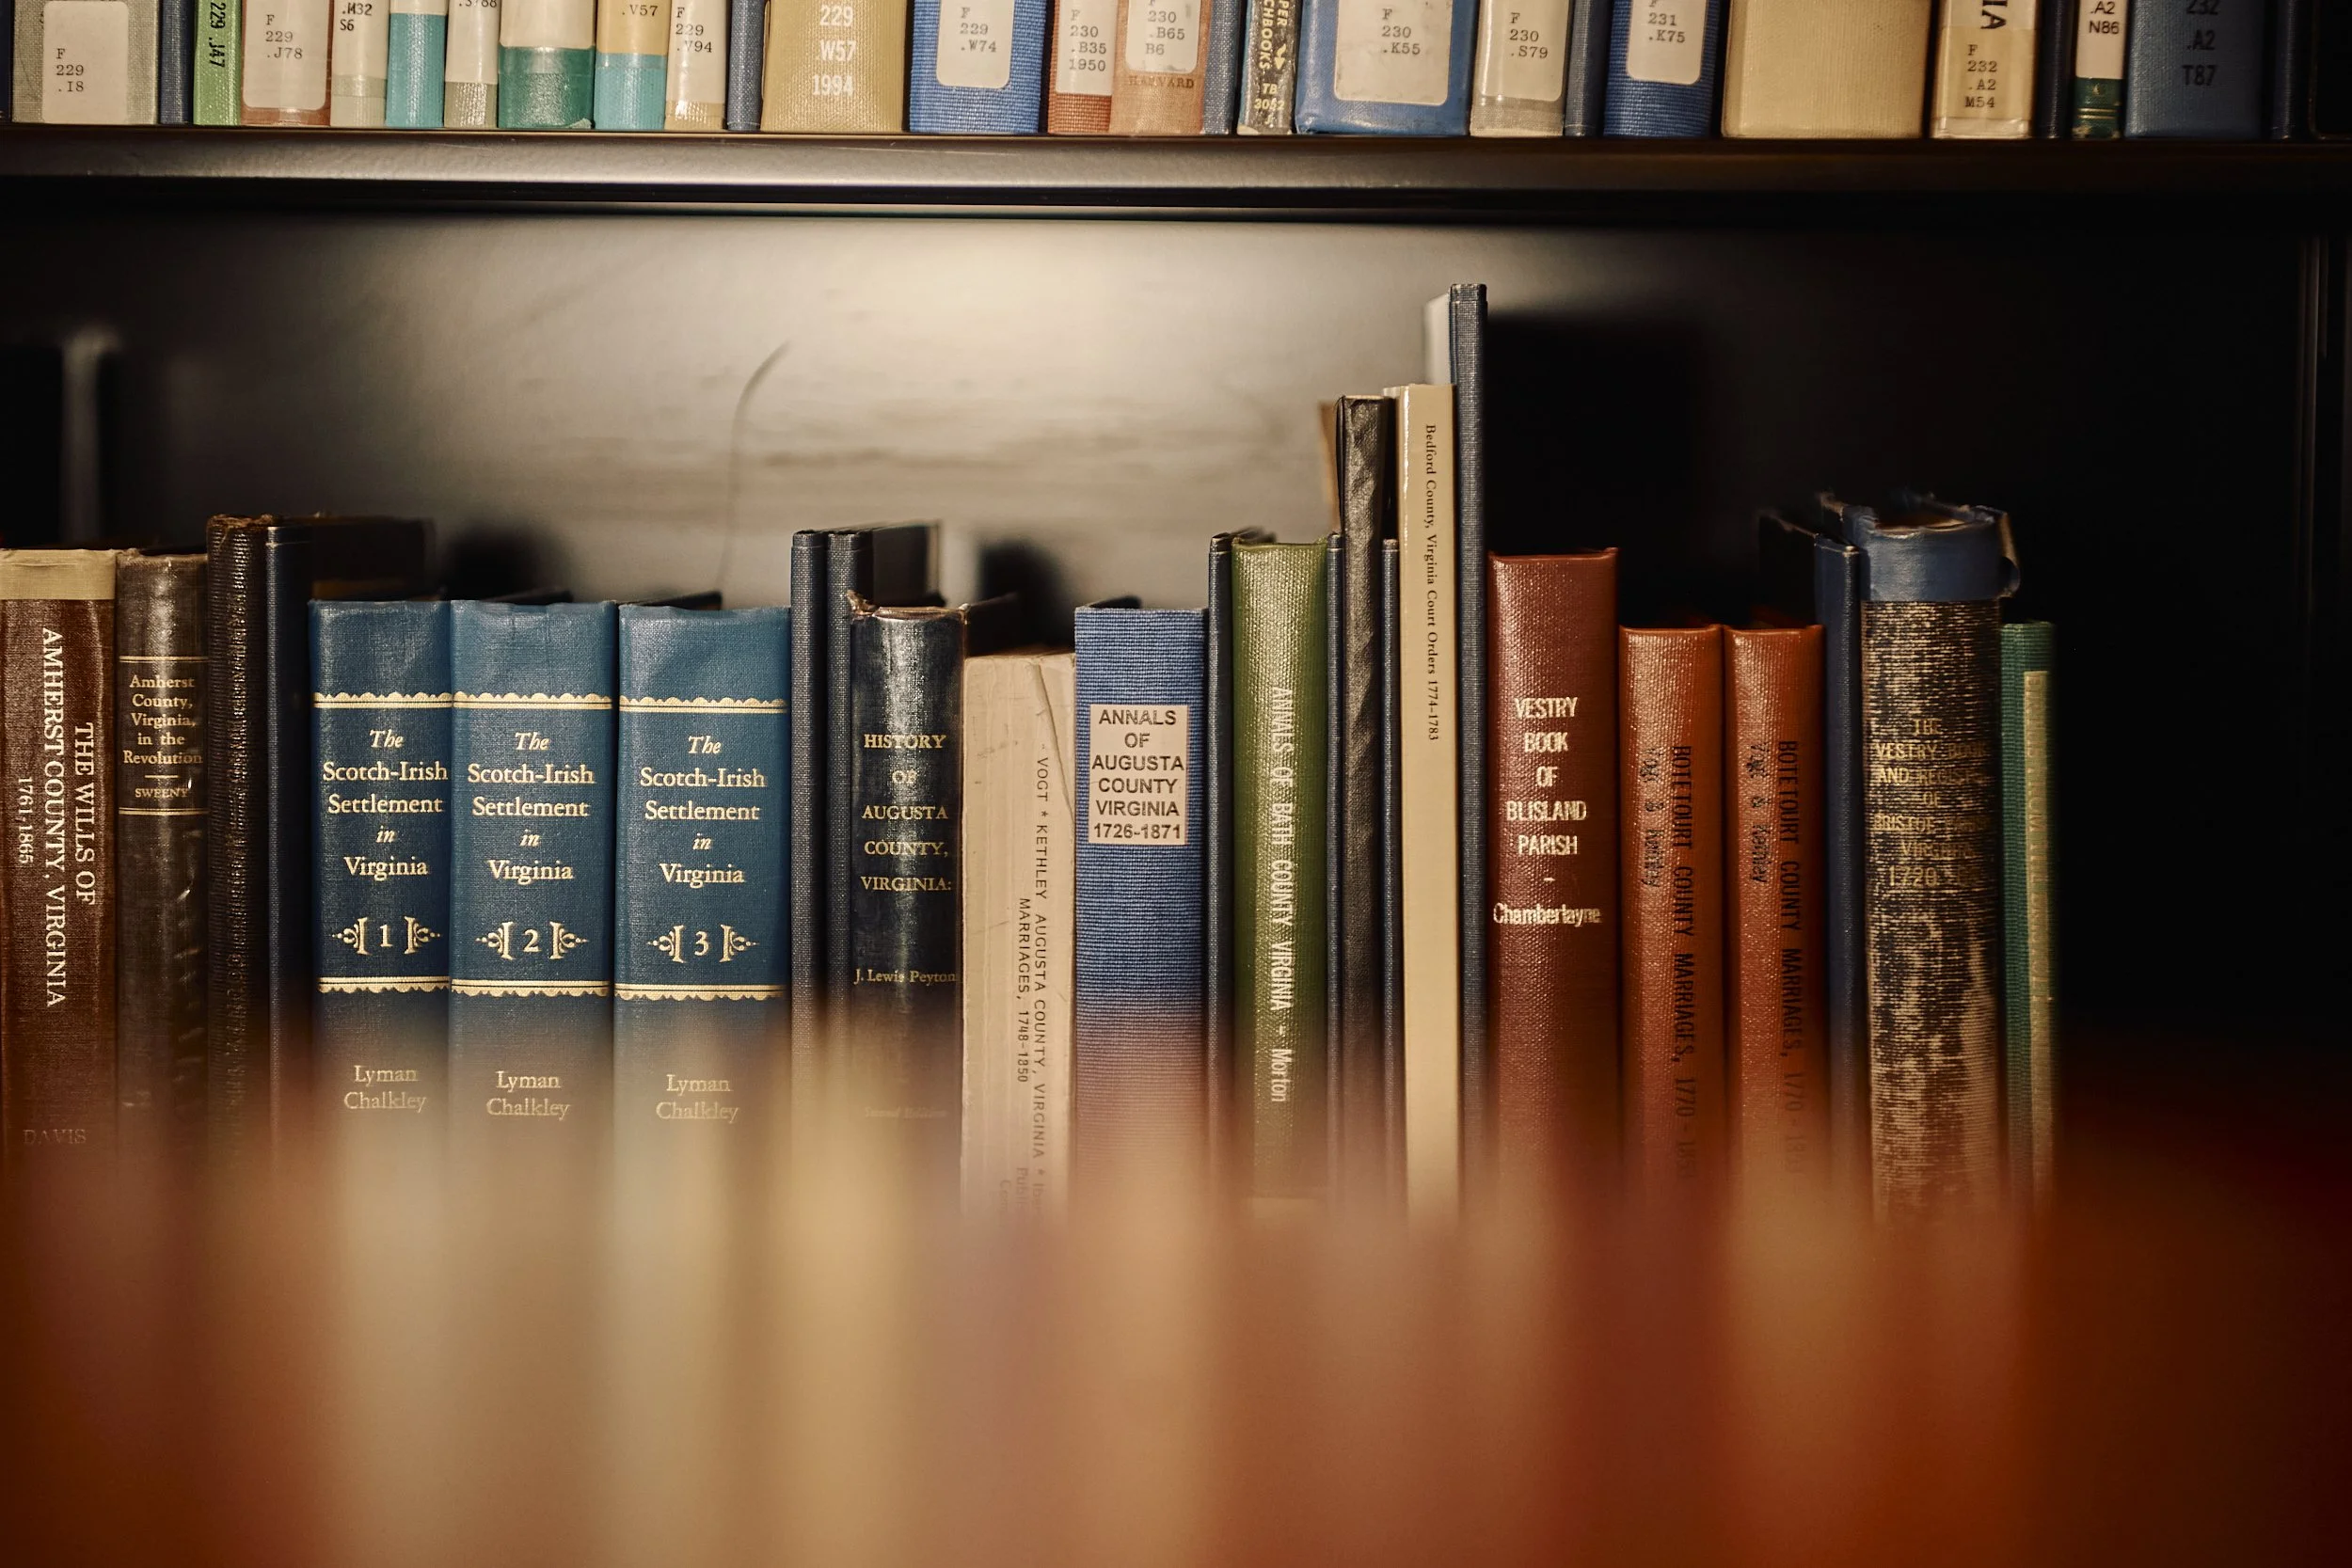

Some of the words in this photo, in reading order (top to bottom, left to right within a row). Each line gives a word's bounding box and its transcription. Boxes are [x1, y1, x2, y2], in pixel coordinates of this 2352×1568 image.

[210, 2, 226, 28] 229
[342, 3, 373, 16] .M32
[622, 5, 659, 17] .V57
[676, 8, 685, 18] F
[819, 4, 853, 26] 229
[961, 8, 970, 19] F
[1072, 10, 1080, 21] F
[1147, 10, 1177, 23] 230
[1383, 9, 1391, 20] F
[2090, 1, 2115, 15] .A2
[266, 15, 275, 25] F
[340, 19, 355, 31] S6
[1510, 13, 1520, 24] F
[1648, 13, 1677, 26] 231
[2090, 21, 2119, 34] N86
[265, 31, 293, 43] 229
[675, 24, 704, 36] 229
[961, 24, 989, 35] 229
[1070, 25, 1099, 38] 230
[1149, 26, 1185, 40] .B65
[1382, 25, 1411, 39] 230
[1509, 29, 1539, 42] 230
[1648, 29, 1685, 43] .K75
[677, 41, 713, 54] .V94
[961, 40, 997, 53] .W74
[1071, 42, 1107, 55] .B35
[1145, 43, 1165, 55] B6
[1383, 42, 1421, 55] .K55
[1967, 44, 1979, 55] F
[2186, 30, 2216, 51] .A2
[56, 48, 66, 59] F
[267, 47, 303, 59] .J78
[1510, 45, 1549, 59] .S79
[56, 65, 84, 76] 229
[1069, 58, 1106, 71] 1950
[1967, 61, 1997, 72] 232
[812, 75, 853, 95] 1994
[1969, 79, 1996, 90] .A2
[2182, 65, 2217, 86] T87
[1262, 83, 1278, 94] TB
[1965, 96, 1995, 108] M54
[1426, 425, 1438, 474] Bedford
[1423, 480, 1438, 529] County,
[1424, 534, 1438, 584] Virginia
[1427, 590, 1438, 626] Court
[1427, 631, 1438, 674] Orders
[43, 627, 64, 755] AMHERST
[130, 674, 196, 689] Amherst
[132, 692, 194, 708] County,
[1515, 697, 1578, 719] VESTRY
[131, 712, 197, 729] Virginia,
[1099, 709, 1177, 725] ANNALS
[1271, 687, 1294, 752] ANNALS
[1428, 680, 1439, 741] 1774-1783
[137, 733, 152, 745] in
[160, 731, 185, 745] the
[369, 729, 405, 749] The
[515, 732, 550, 752] The
[687, 736, 723, 755] The
[864, 734, 946, 749] HISTORY
[1124, 732, 1151, 749] OF
[1524, 732, 1568, 752] BOOK
[74, 722, 94, 776] THE
[123, 750, 204, 765] Revolution
[1875, 743, 1938, 760] VESTRY
[323, 761, 449, 783] Scotch-Irish
[1091, 754, 1184, 771] AUGUSTA
[468, 763, 596, 785] Scotch-Irish
[640, 768, 767, 789] Scotch-Irish
[1037, 756, 1049, 801] VOGT
[1271, 767, 1294, 788] OF
[1535, 766, 1559, 787] OF
[1879, 768, 1910, 784] AND
[135, 788, 190, 800] SWEENY
[1098, 777, 1178, 794] COUNTY
[1778, 740, 1799, 844] BOTETOURT
[328, 794, 443, 814] Settlement
[1672, 745, 1692, 849] BOTETOURT
[472, 797, 590, 818] Settlement
[644, 800, 760, 821] Settlement
[862, 805, 949, 820] AUGUSTA
[1095, 800, 1180, 816] VIRGINIA
[1506, 800, 1587, 821] BLISLAND
[74, 783, 95, 863] WILLS
[1094, 823, 1181, 839] 1726-1871
[1271, 803, 1294, 846] BATH
[376, 826, 396, 844] in
[520, 830, 540, 847] in
[692, 833, 712, 851] in
[1518, 835, 1578, 855] PARISH
[864, 840, 949, 858] COUNTY,
[344, 857, 429, 882] Virginia
[1036, 824, 1048, 899] KETHLEY
[487, 860, 574, 885] Virginia
[660, 863, 746, 889] Virginia
[75, 871, 96, 905] OF
[861, 876, 952, 892] VIRGINIA:
[1271, 860, 1294, 927] COUNTY
[1674, 865, 1693, 936] COUNTY
[1781, 860, 1802, 930] COUNTY
[1493, 902, 1601, 927] Chamberlayne
[46, 885, 67, 1007] VIRGINIA
[378, 925, 390, 947] 1
[523, 929, 539, 953] 2
[694, 931, 710, 956] 3
[1016, 897, 1031, 1000] MARRIAGES,
[1034, 913, 1047, 992] AUGUSTA
[853, 969, 864, 985] J.
[867, 969, 905, 983] Lewis
[909, 970, 957, 986] Peyton
[1271, 941, 1295, 1011] VIRGINIA
[1671, 953, 1694, 1062] MARRIAGES,
[1017, 1010, 1029, 1083] 1748-1850
[1032, 999, 1046, 1074] COUNTY,
[354, 1065, 420, 1087] Lyman
[495, 1070, 562, 1093] Lyman
[666, 1073, 732, 1097] Lyman
[1271, 1048, 1293, 1102] Morton
[343, 1091, 427, 1114] Chalkley
[1676, 1077, 1695, 1117] 1770
[485, 1097, 571, 1121] Chalkley
[656, 1101, 740, 1124] Chalkley
[1033, 1083, 1046, 1159] VIRGINIA
